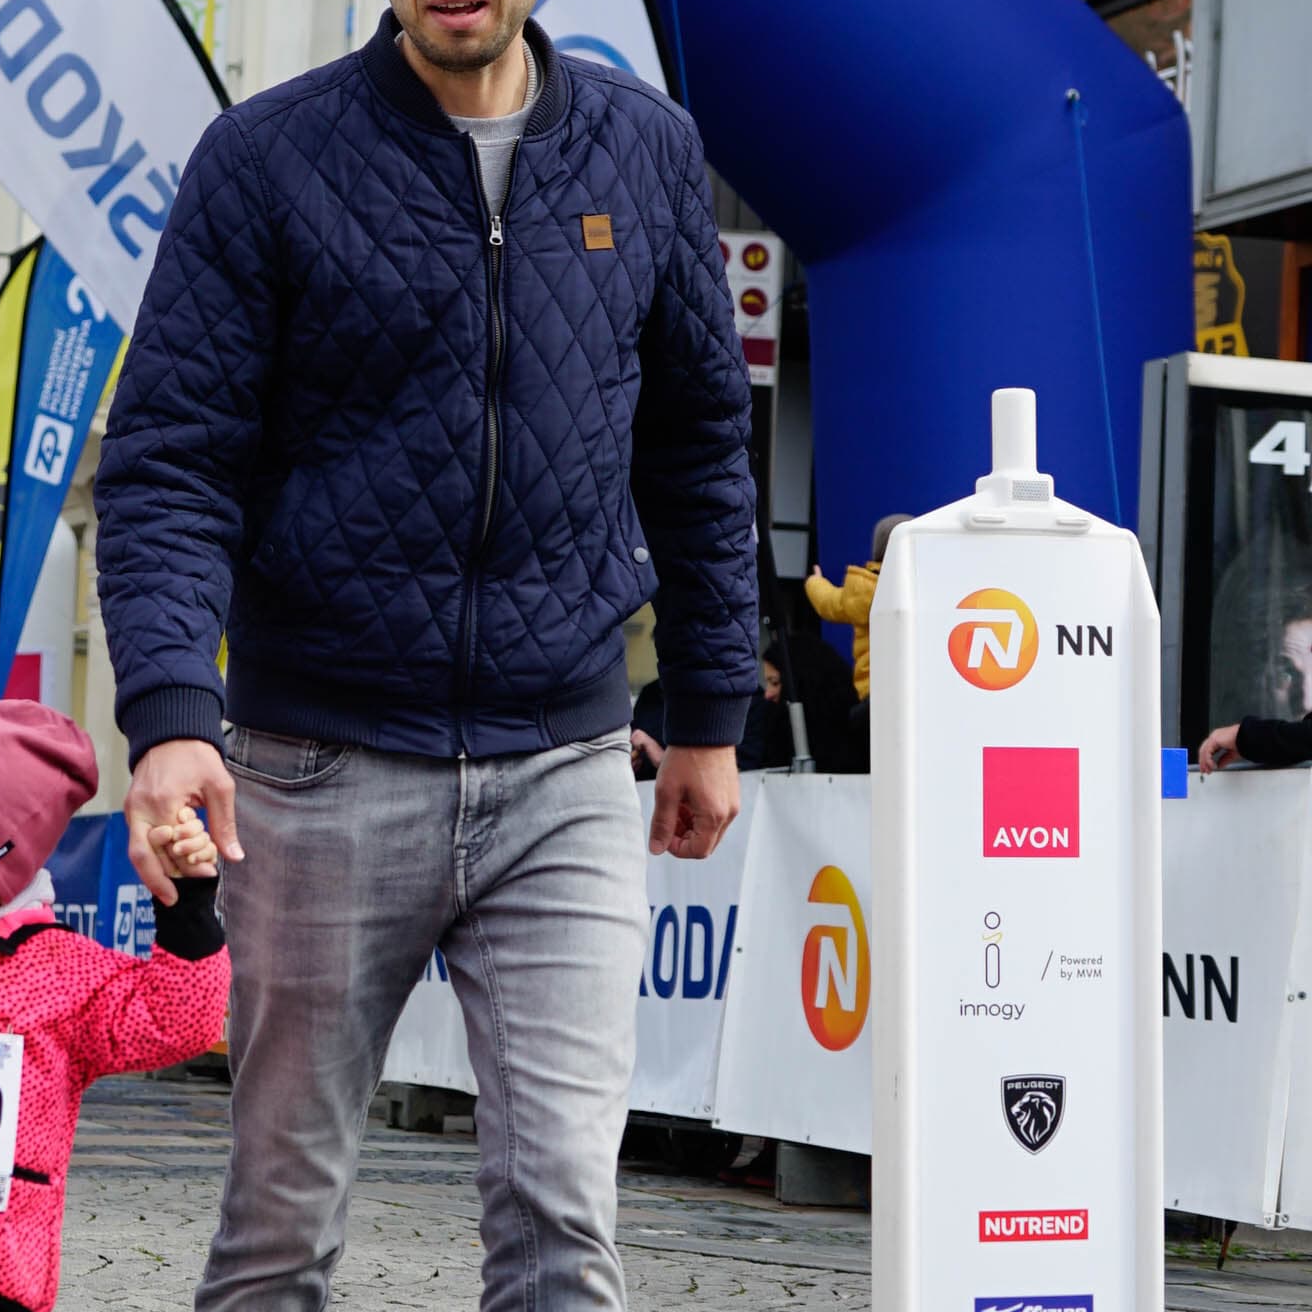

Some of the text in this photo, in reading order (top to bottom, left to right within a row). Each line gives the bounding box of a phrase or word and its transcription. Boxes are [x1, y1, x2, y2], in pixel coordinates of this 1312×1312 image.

[1055, 624, 1113, 657] NN
[992, 826, 1069, 849] AVON
[1060, 955, 1103, 966] Powered
[1060, 968, 1103, 981] by MVM
[1163, 951, 1239, 1023] NN
[959, 999, 1025, 1021] innogy
[1006, 1080, 1061, 1091] PEUGEOT
[985, 1215, 1085, 1236] NUTREND
